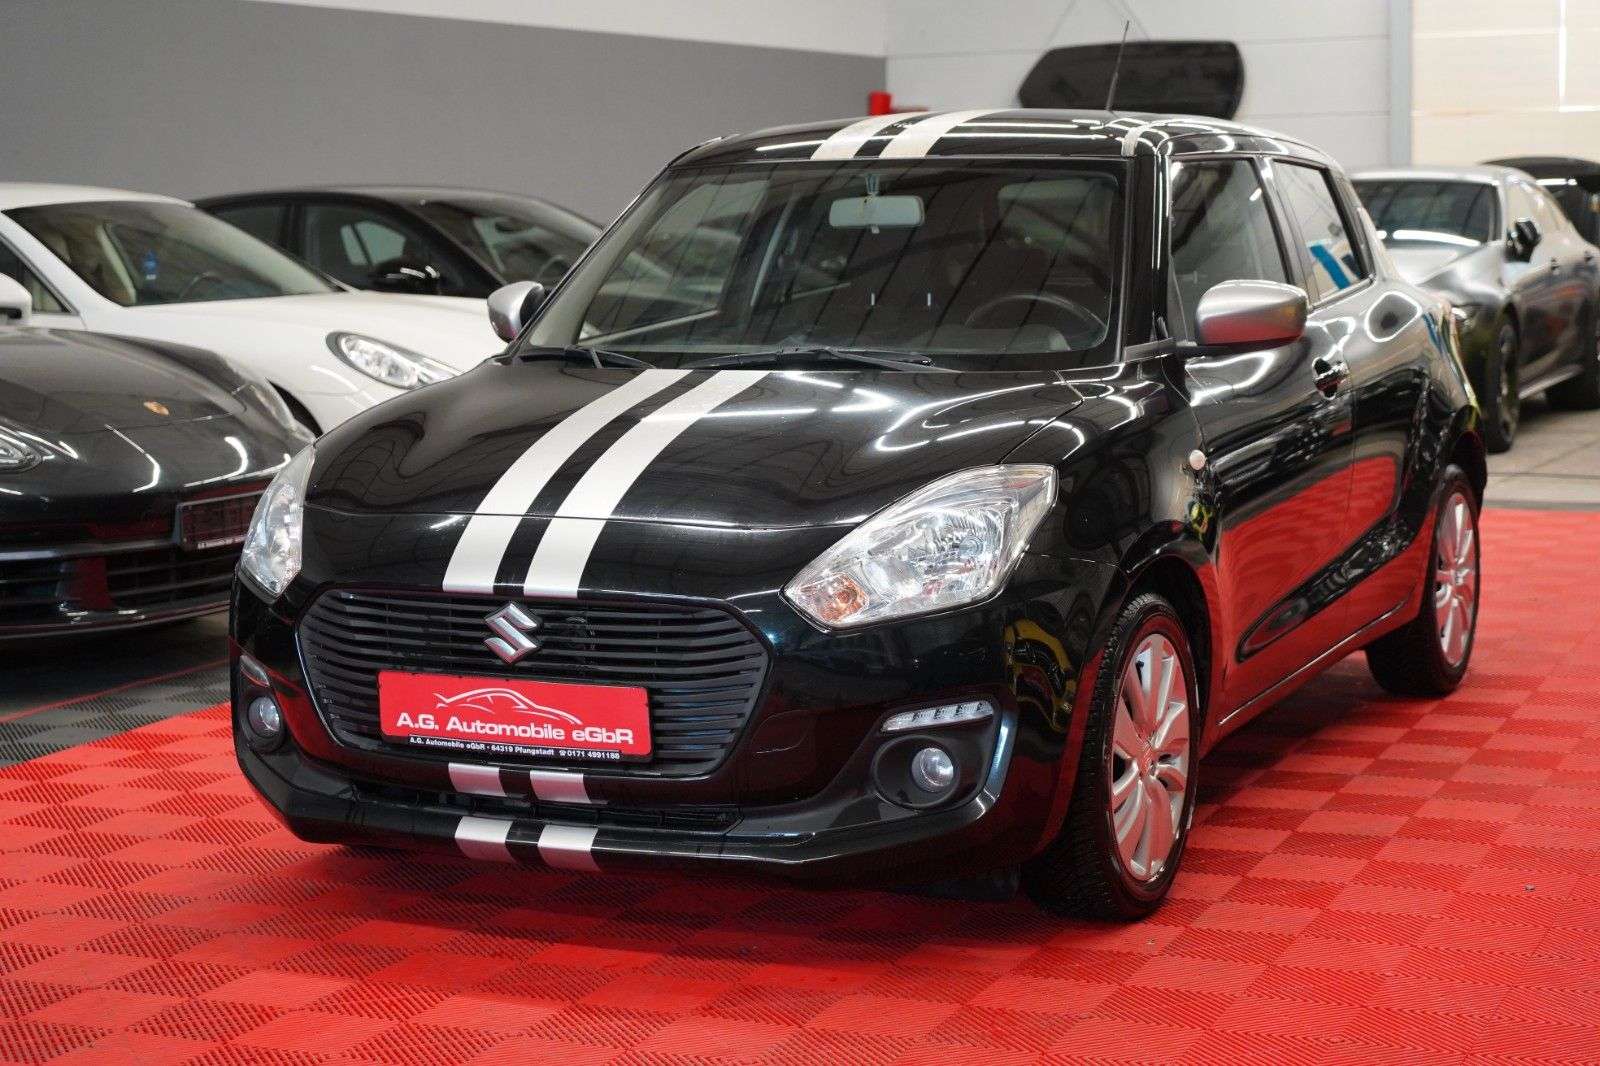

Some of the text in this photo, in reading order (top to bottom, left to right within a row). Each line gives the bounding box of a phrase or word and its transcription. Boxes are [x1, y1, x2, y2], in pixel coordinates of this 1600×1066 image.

[396, 712, 634, 745] A.G. Automobile eGbR
[425, 738, 465, 749] Automobile
[514, 745, 555, 756] Pfungstadt
